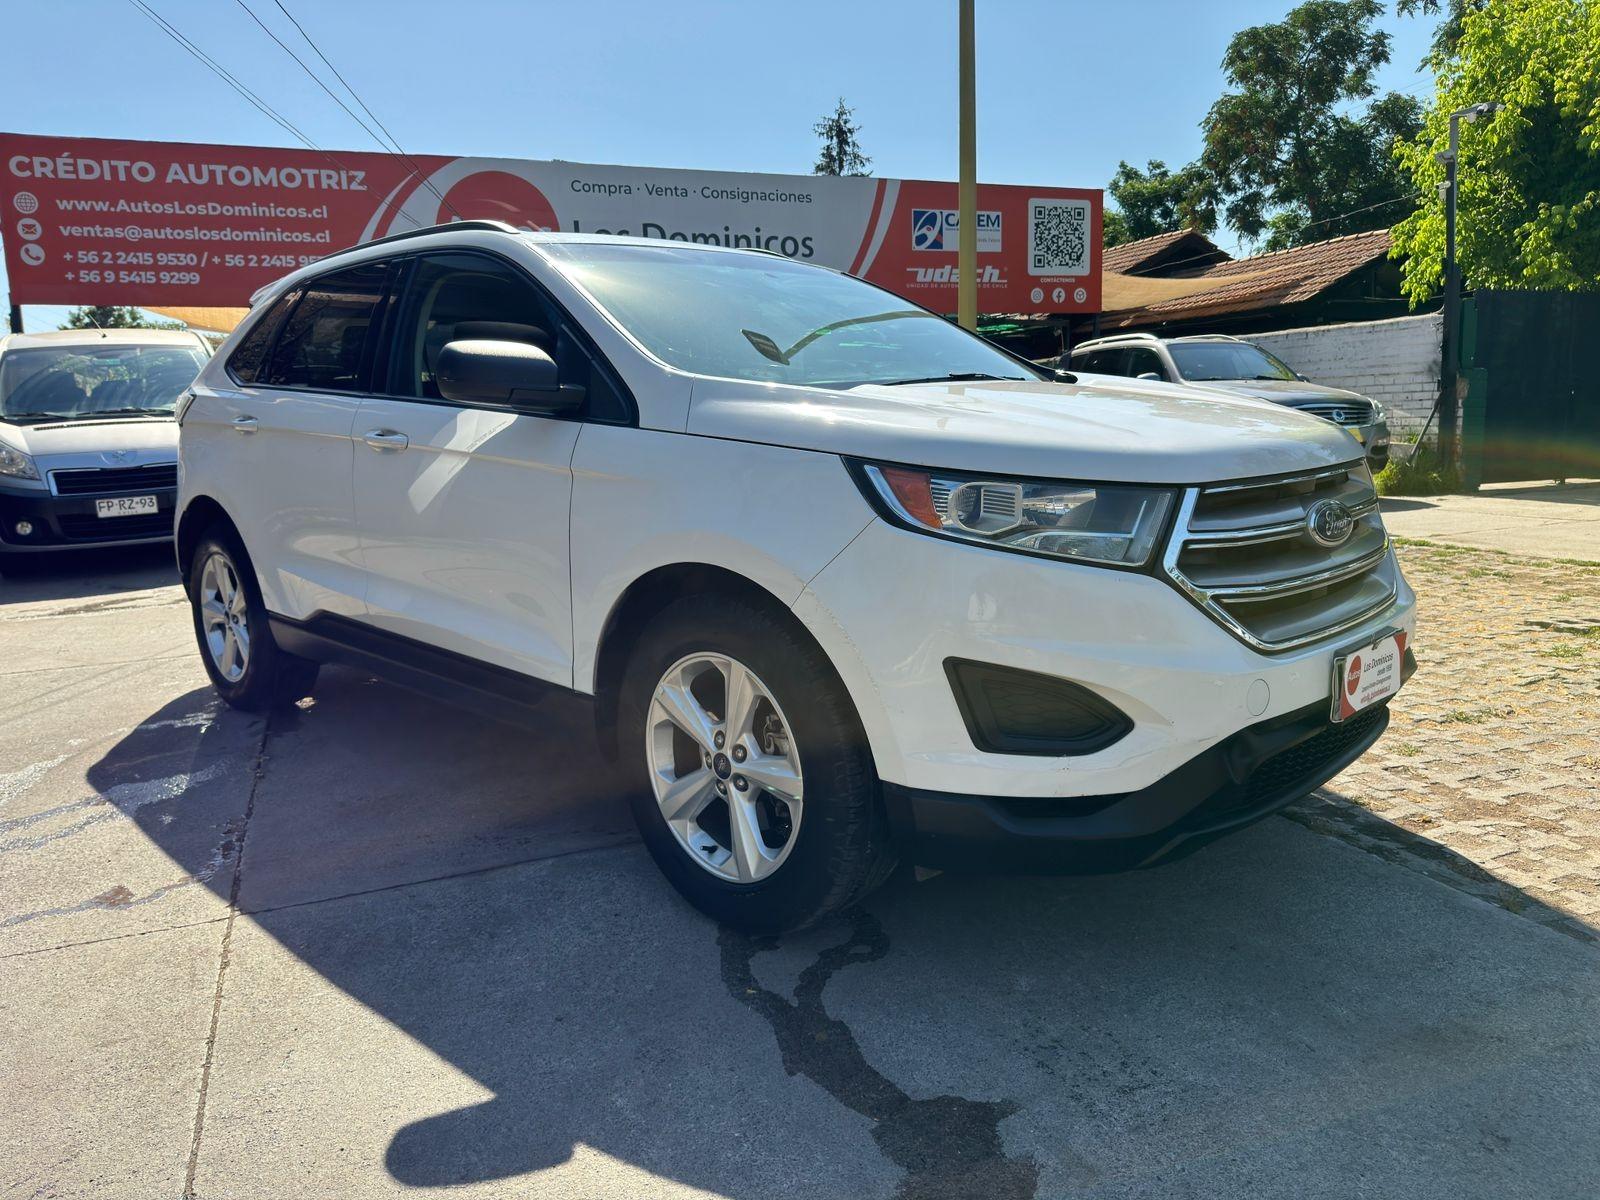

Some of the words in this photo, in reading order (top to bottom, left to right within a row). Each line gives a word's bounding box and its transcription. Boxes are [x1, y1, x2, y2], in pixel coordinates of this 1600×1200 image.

[9, 152, 156, 183] CRÉDITO
[166, 163, 368, 191] AUTOMOTRIZ
[570, 179, 632, 197] Compra
[644, 183, 688, 198] Venta
[701, 186, 813, 204] Consignaciones
[56, 198, 327, 219] www.AutosLosDominicos.cl
[59, 225, 330, 243] ventas@autoslosdominicos.cl
[77, 250, 99, 263] 56
[102, 251, 113, 264] 2
[116, 251, 154, 265] 2415
[156, 252, 197, 266] 9530
[225, 253, 245, 267] 56
[247, 254, 258, 267] 2
[261, 255, 296, 267] 2415
[79, 270, 101, 283] 56
[104, 270, 115, 283] 9
[119, 271, 156, 284] 5415
[160, 271, 200, 285] 9299
[1325, 510, 1352, 536] Ford
